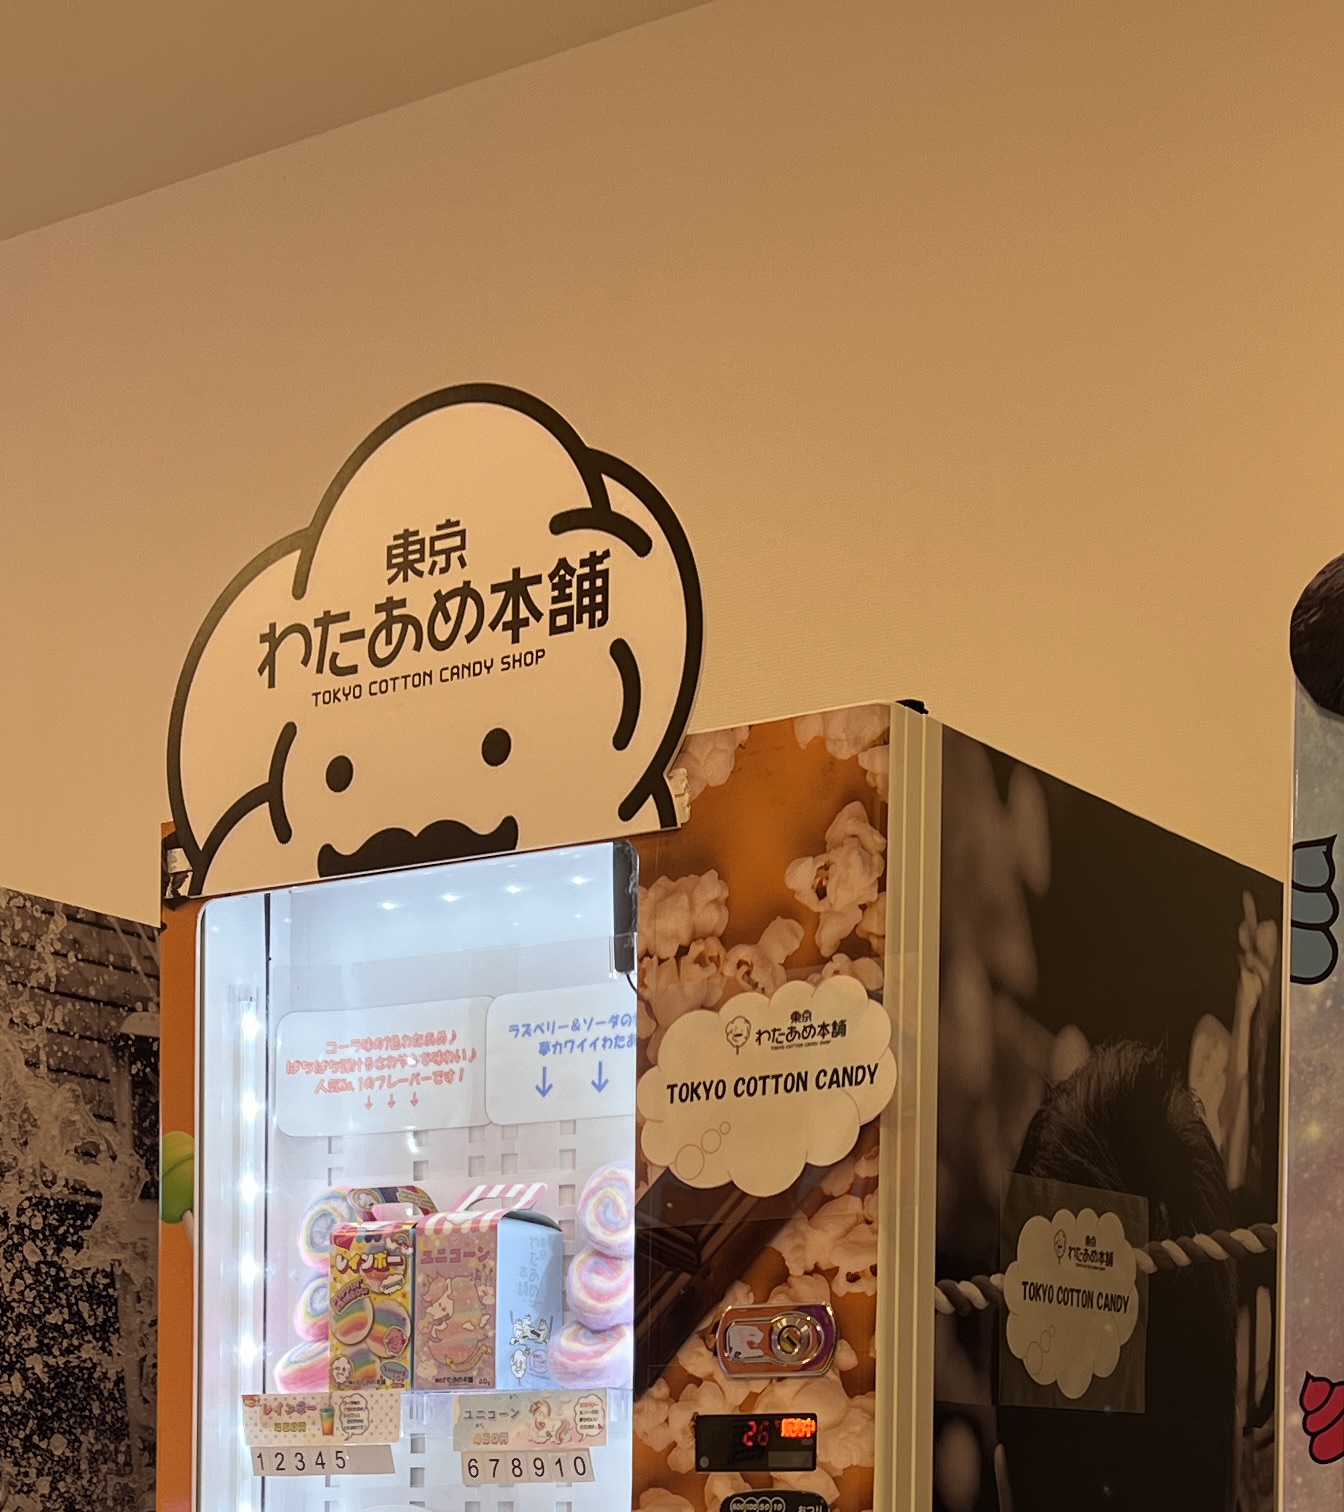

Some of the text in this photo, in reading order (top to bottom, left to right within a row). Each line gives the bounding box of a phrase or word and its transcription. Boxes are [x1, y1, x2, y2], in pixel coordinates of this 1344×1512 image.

[387, 519, 468, 585] 東京
[258, 549, 611, 689] わたあめ本舗
[311, 649, 546, 708] TOKYO COTTON CANDY SHOP
[755, 1019, 847, 1046] わたあめ本舗
[666, 1063, 879, 1104] TOKYO COTTON CANDY
[335, 1253, 405, 1274] レインボー
[420, 1247, 491, 1265] ユニコーン
[1022, 1281, 1130, 1314] TOKYO COTTON CANDY
[463, 1408, 520, 1420] ユニコーン
